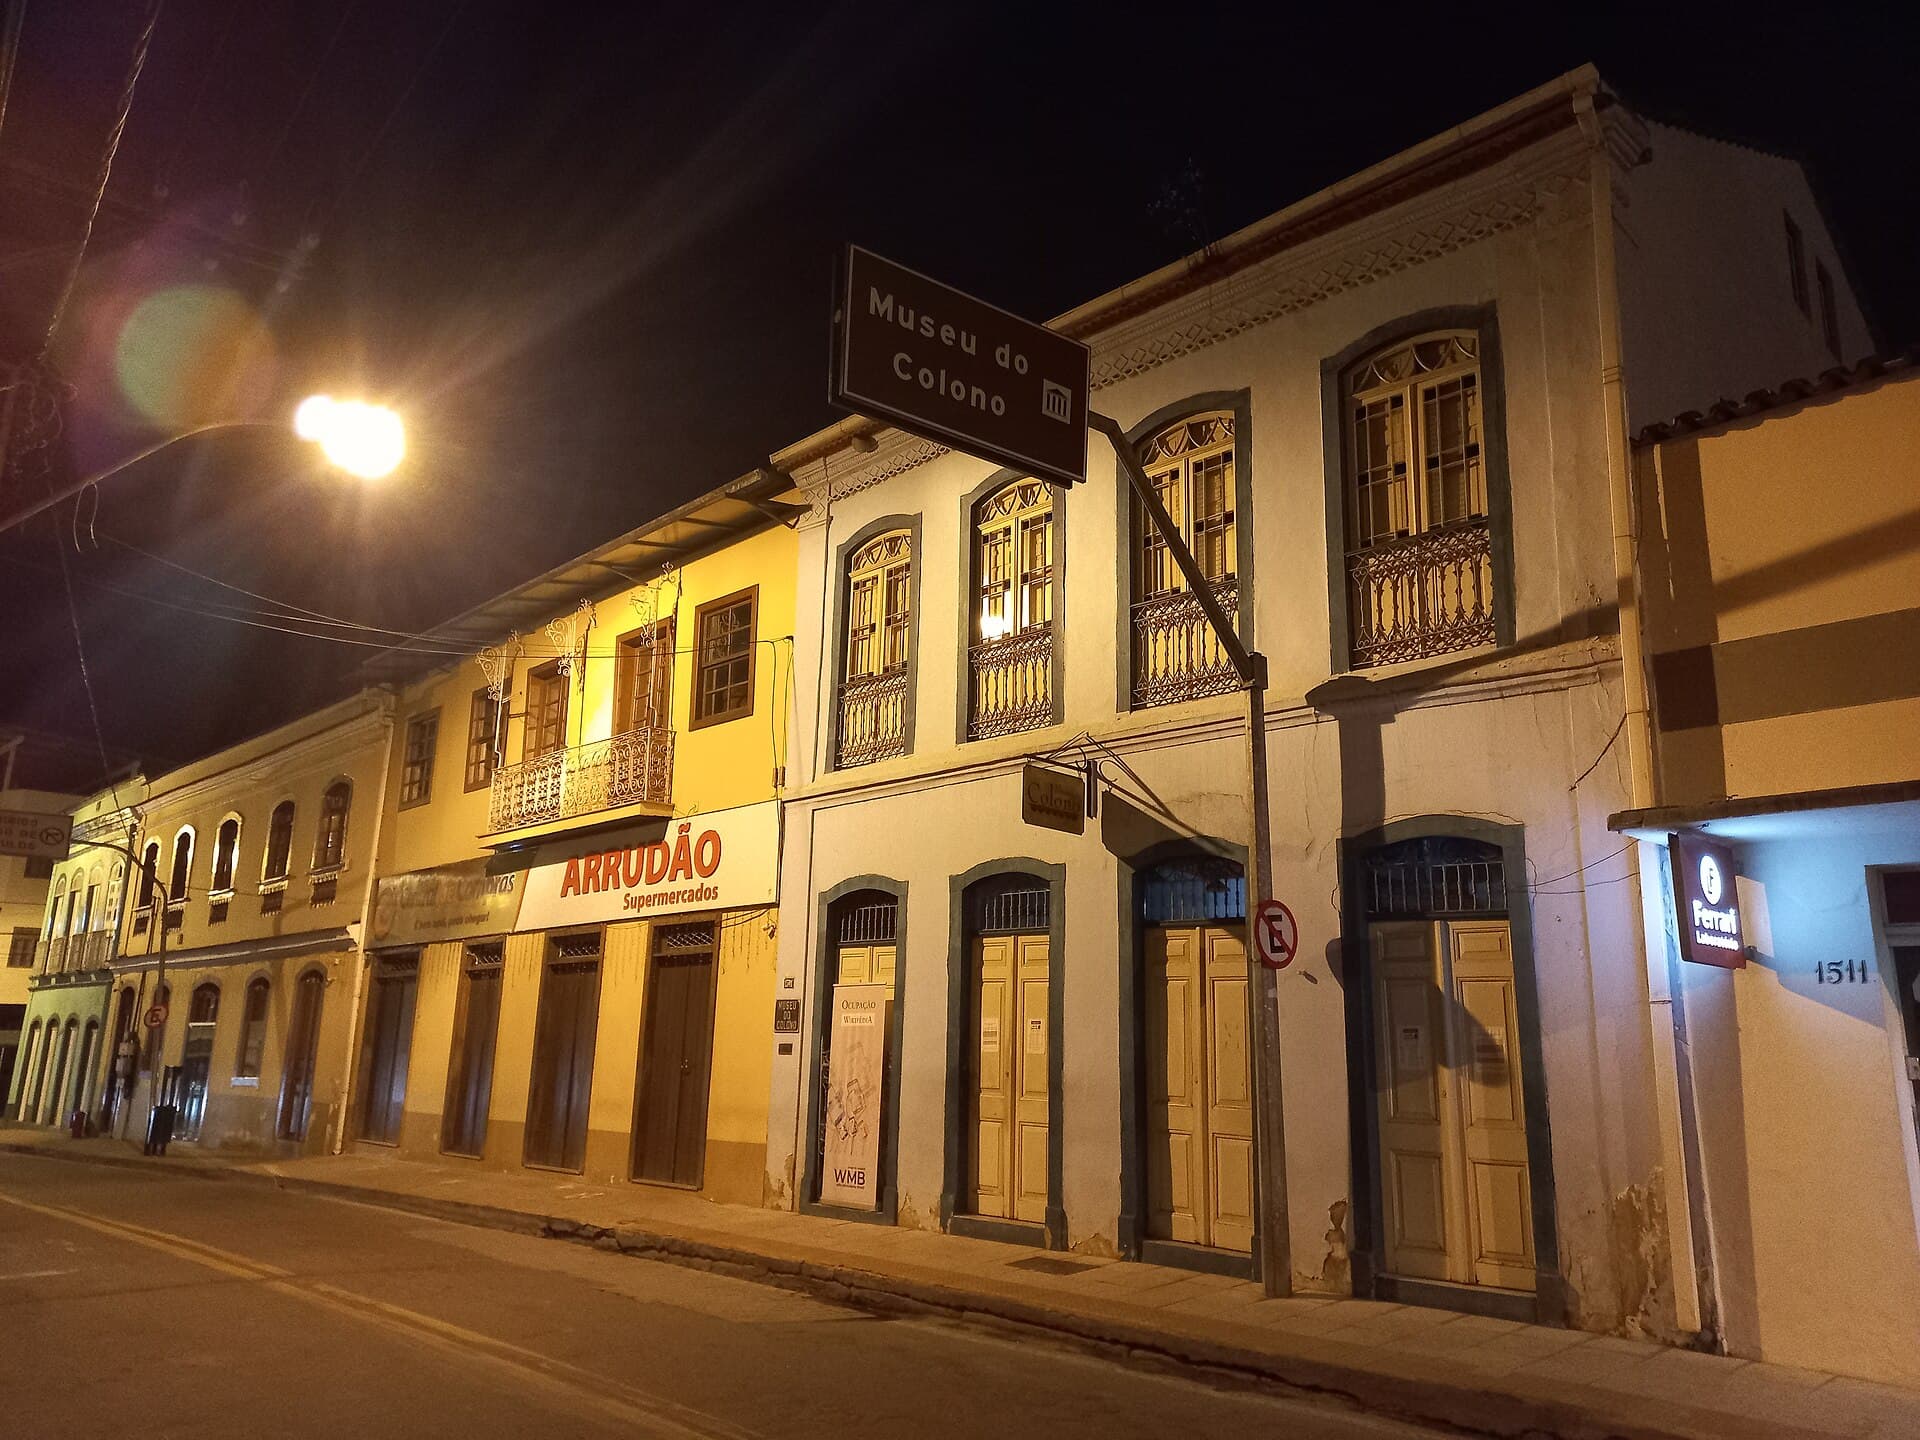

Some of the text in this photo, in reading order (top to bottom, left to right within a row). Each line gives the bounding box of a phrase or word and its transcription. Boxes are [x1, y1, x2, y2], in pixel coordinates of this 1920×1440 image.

[869, 285, 1029, 376] Museu do
[892, 352, 1006, 417] Colono
[560, 822, 722, 898] ARRUDÃO
[622, 882, 719, 913] Supermercados
[1692, 899, 1737, 935] Ferrari
[1815, 959, 1868, 985] 1511
[833, 1167, 866, 1186] WMB
